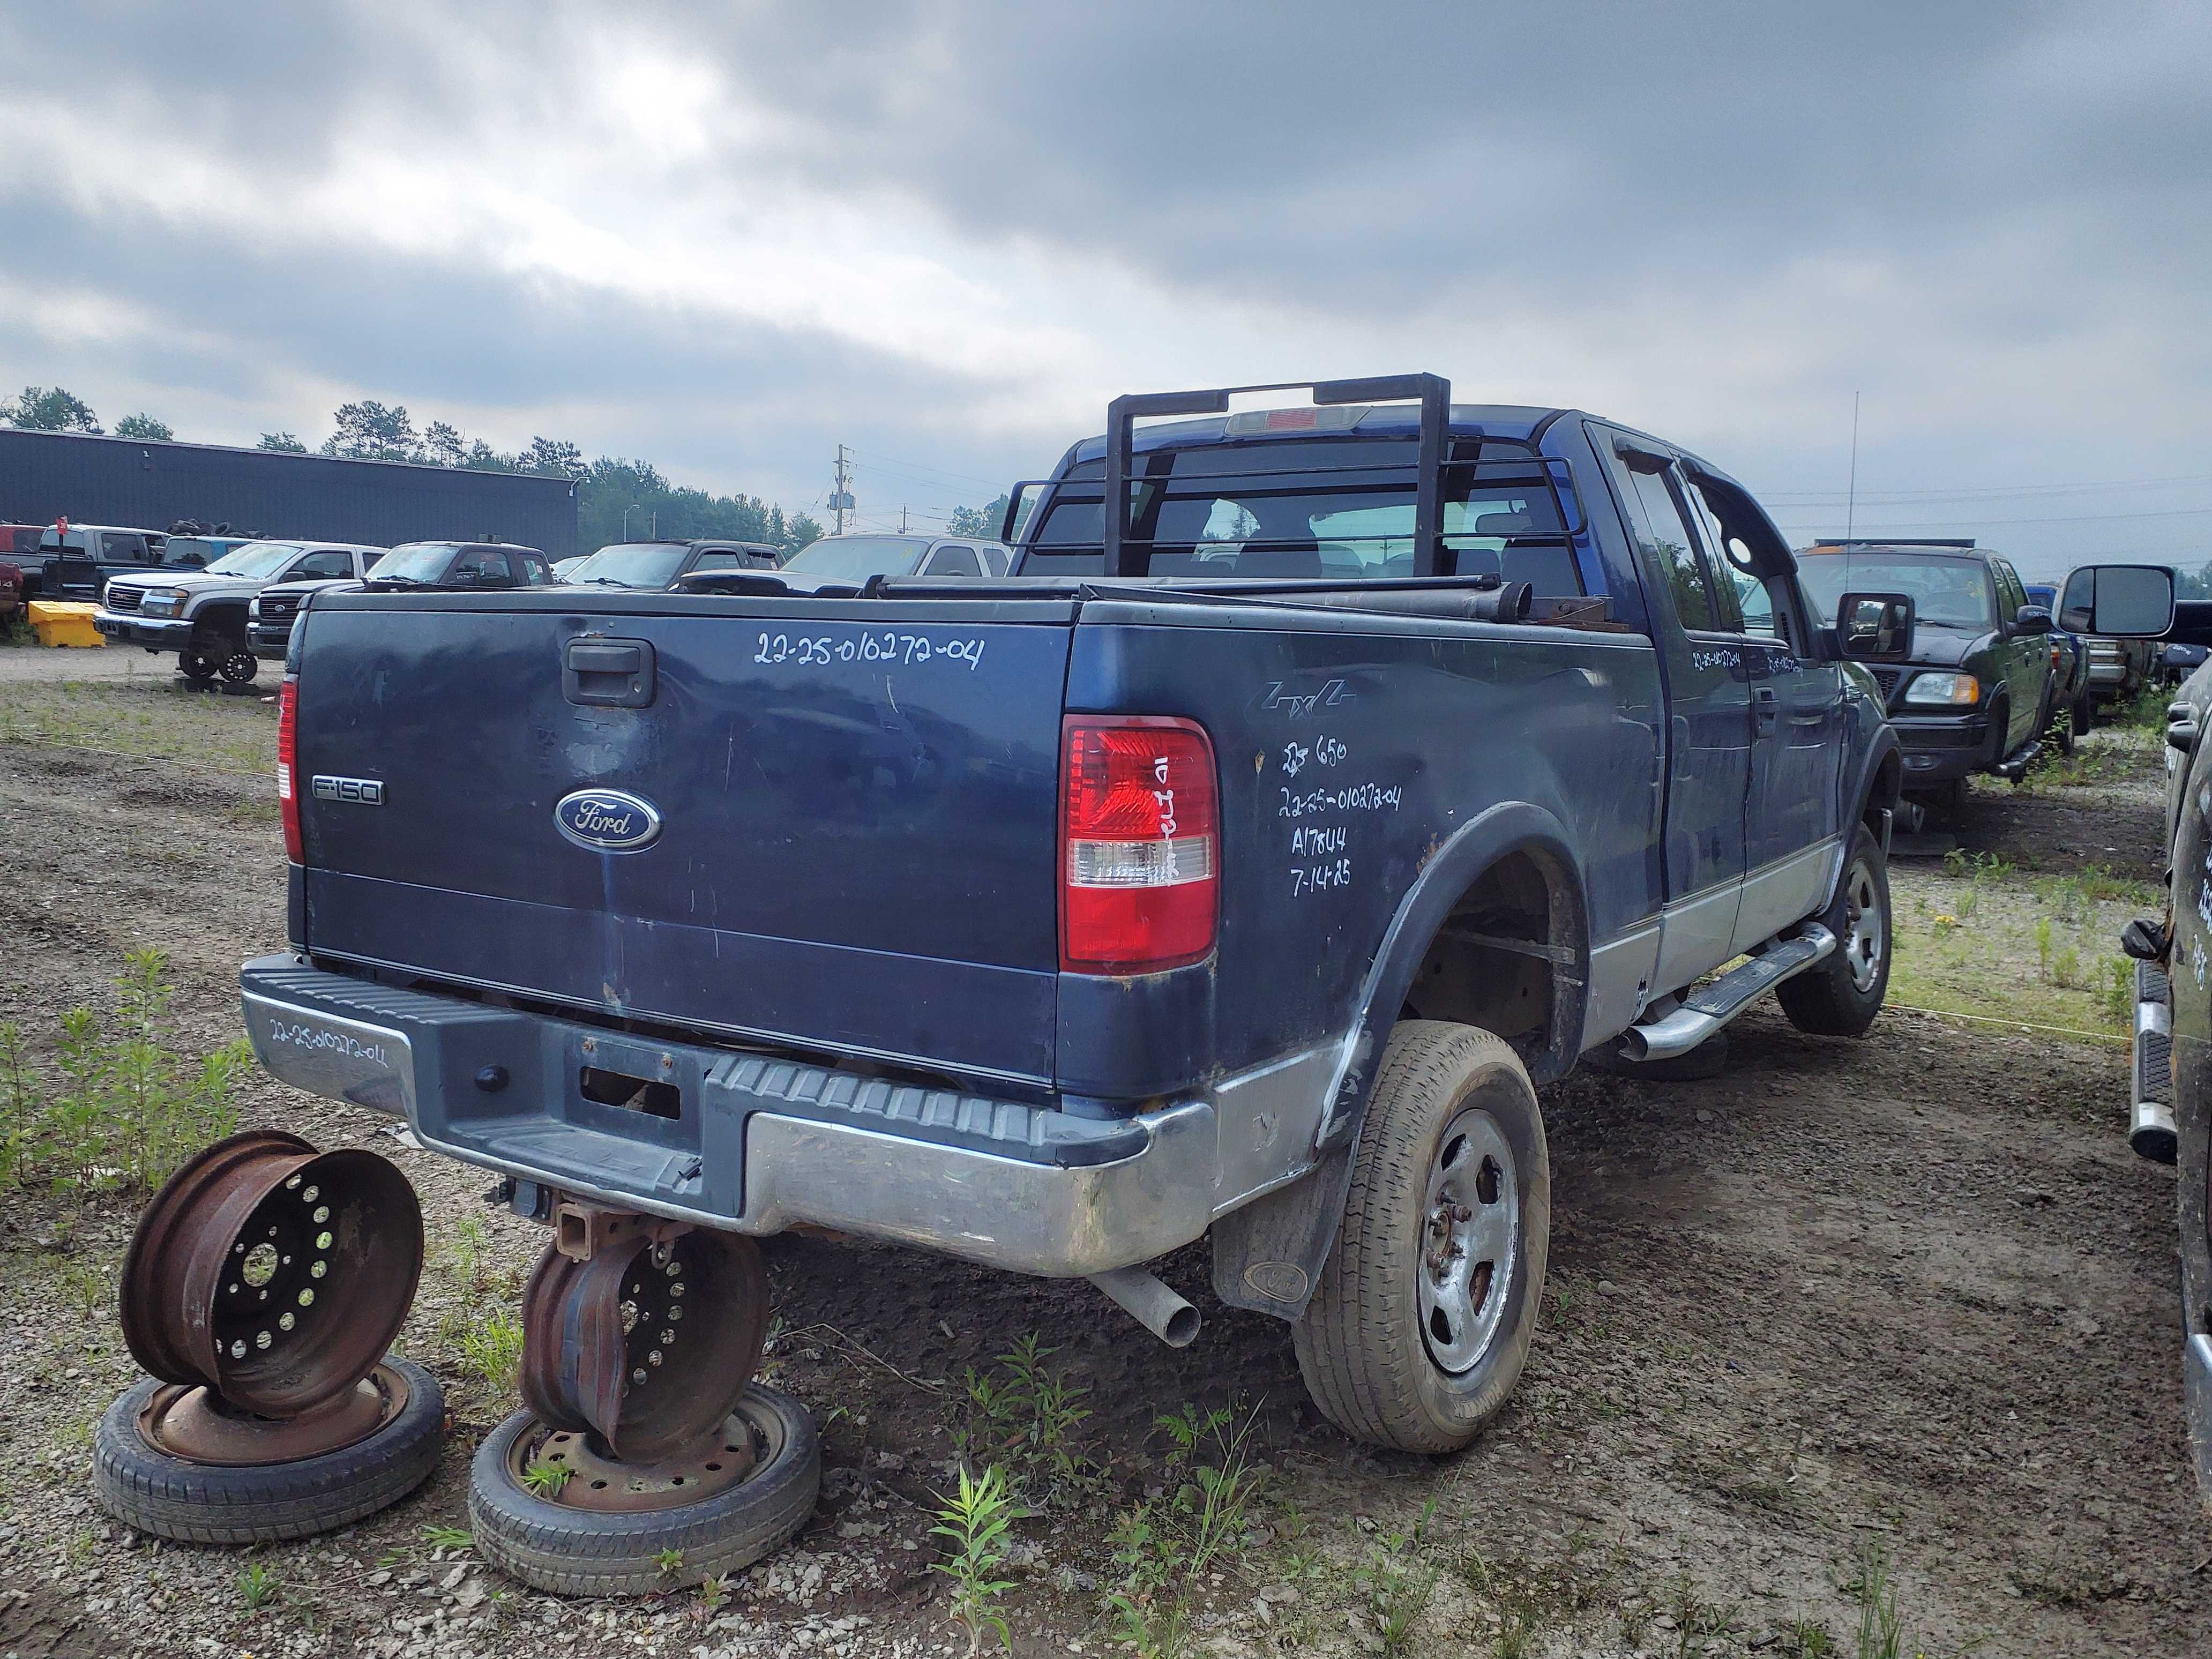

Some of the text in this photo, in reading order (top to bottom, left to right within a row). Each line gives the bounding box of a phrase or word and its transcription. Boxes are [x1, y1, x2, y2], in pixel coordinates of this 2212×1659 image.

[753, 631, 986, 671] 22-25-010272-04
[1316, 734, 1347, 767] 650
[574, 799, 632, 836] Ford
[1279, 782, 1402, 818] 22-25-010272-04
[1290, 858, 1351, 897] 7-14-25
[270, 1019, 388, 1068] 22-25-010272-04
